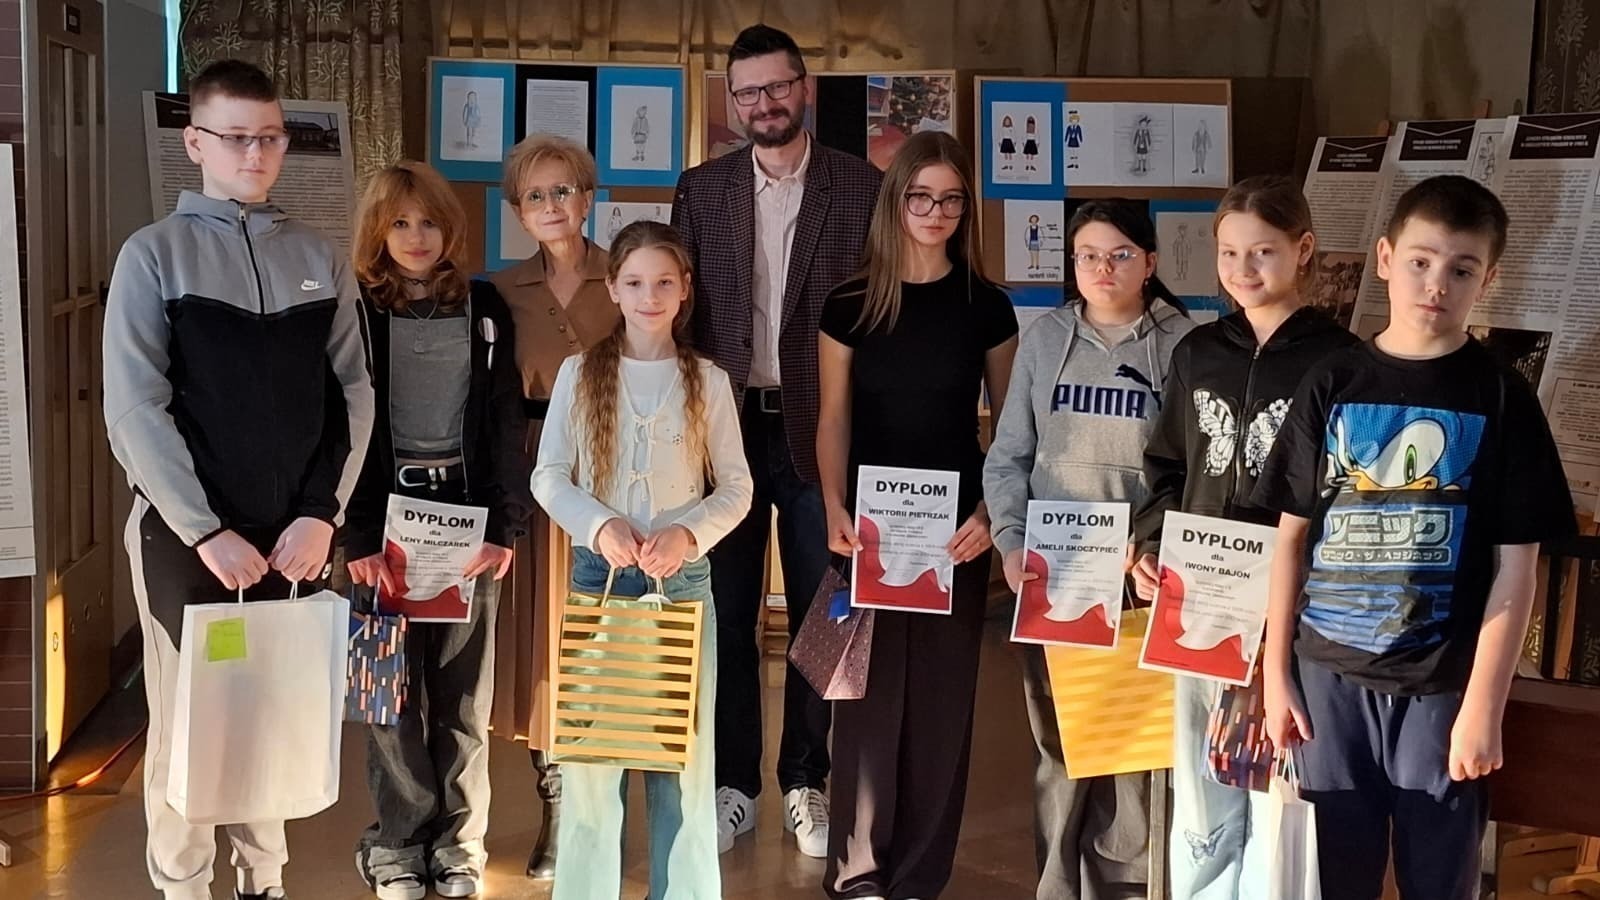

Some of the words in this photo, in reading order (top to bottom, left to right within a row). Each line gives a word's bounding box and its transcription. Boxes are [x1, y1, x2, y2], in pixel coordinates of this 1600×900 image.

[1052, 384, 1146, 419] PUMA
[875, 480, 948, 497] DYPLOM
[404, 509, 475, 529] DYPLOM
[868, 508, 907, 517] WIKTORII
[908, 511, 949, 520] PIETRZAK
[1042, 512, 1114, 528] DYPLOM
[429, 529, 441, 537] dla
[400, 535, 421, 543] LENY
[423, 539, 470, 548] MILCZAREK
[1035, 543, 1064, 551] AMELII
[1065, 545, 1119, 554] SKOCZYPIEC
[1182, 529, 1264, 555] DYPLOM
[1210, 553, 1225, 562] dla
[1185, 561, 1215, 574] IWONY
[1218, 567, 1251, 579] BAJON
